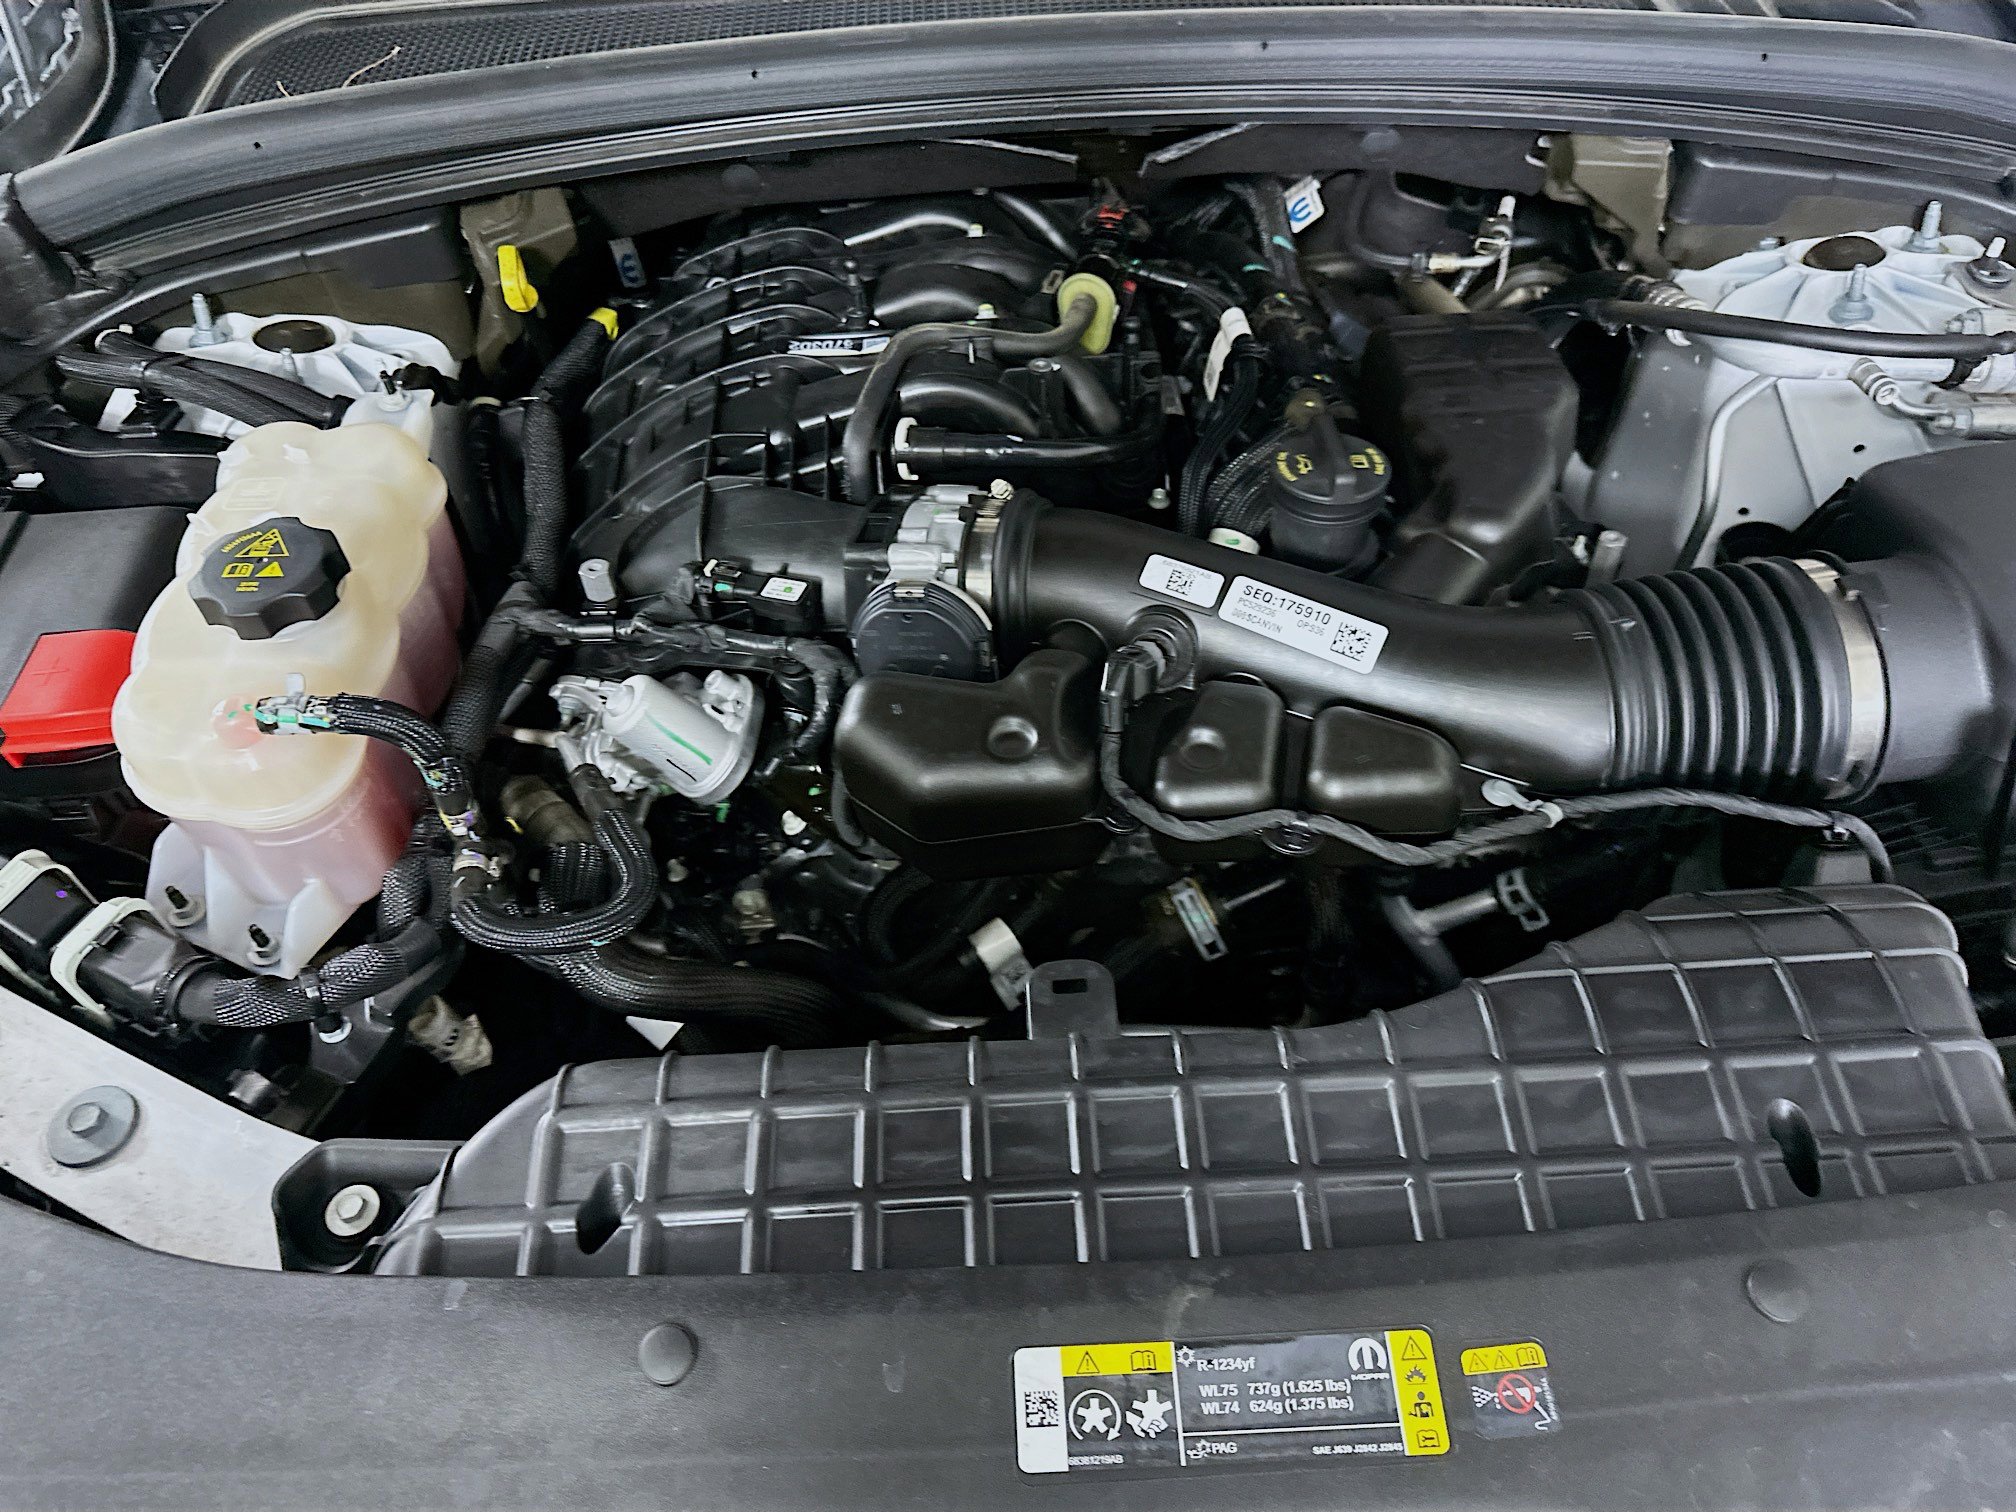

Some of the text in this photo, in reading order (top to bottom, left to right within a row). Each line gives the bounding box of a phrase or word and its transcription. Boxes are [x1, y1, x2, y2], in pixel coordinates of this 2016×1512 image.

[1243, 585, 1332, 625] SEQ:175910
[1196, 1357, 1256, 1373] R-1234yf
[1199, 1378, 1352, 1398] WL75 737g (1.625 lbs)
[1200, 1395, 1355, 1415] WL74 624g (1.375 lbs)
[1211, 1441, 1238, 1455] PAG
